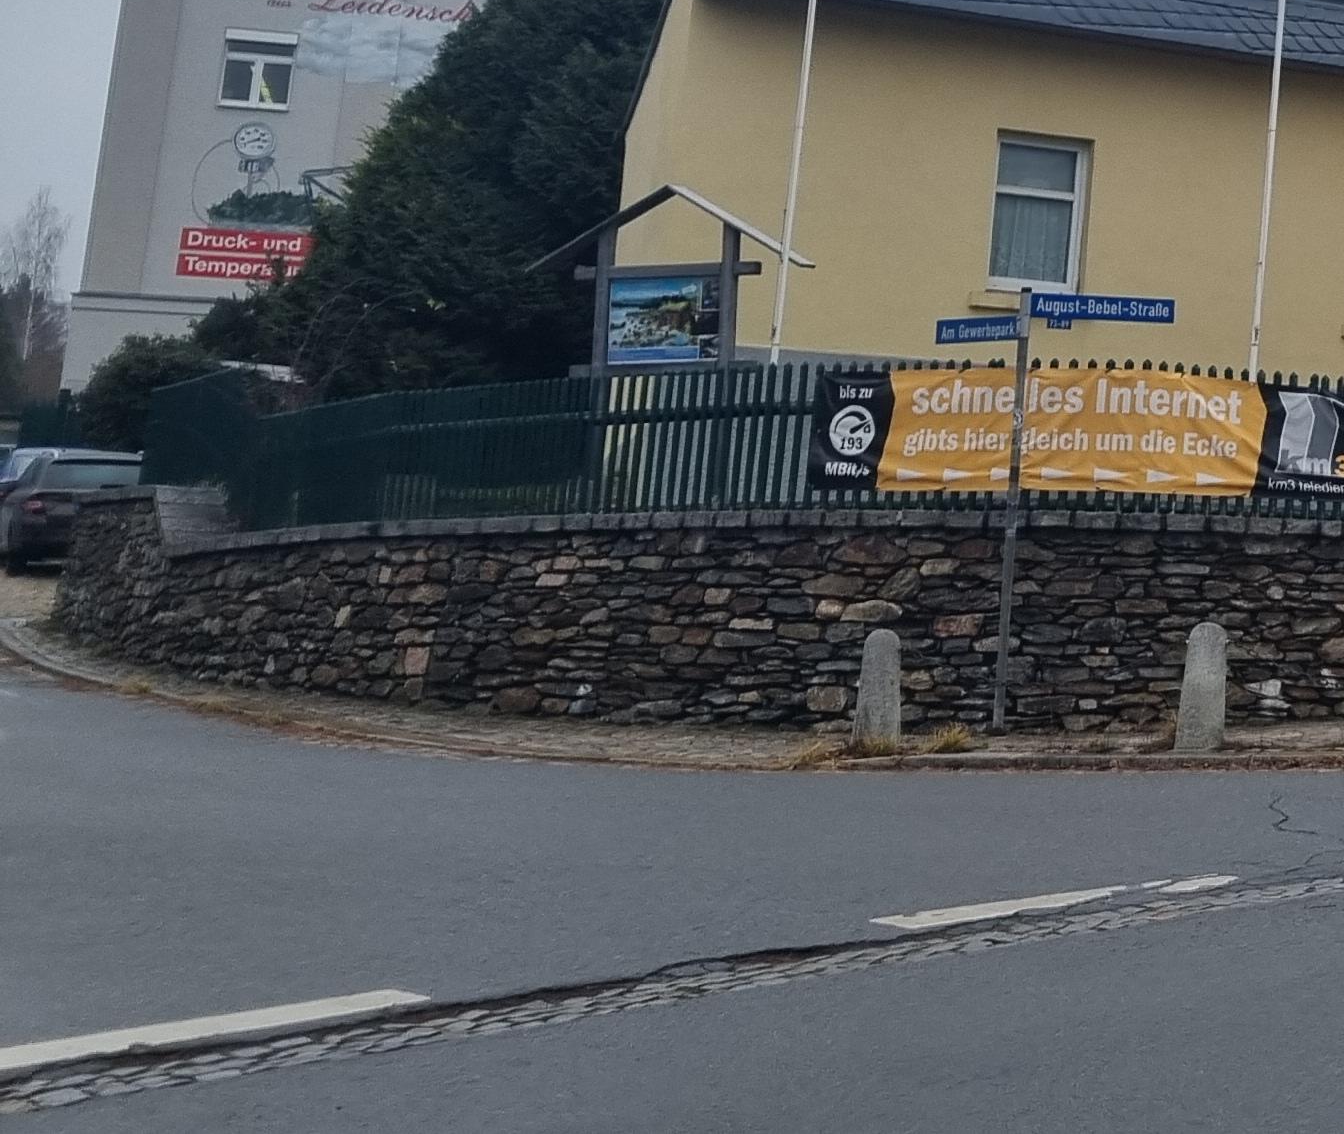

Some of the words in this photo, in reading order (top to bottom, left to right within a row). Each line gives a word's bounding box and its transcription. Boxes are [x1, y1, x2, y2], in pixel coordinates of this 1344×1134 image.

[187, 230, 257, 250] Druck-
[263, 237, 302, 252] und
[1036, 298, 1170, 318] August-Bebel-Straße
[940, 325, 955, 341] Am
[958, 320, 1017, 341] Gewerbepark
[839, 385, 857, 399] bis
[858, 387, 873, 399] zu
[1095, 377, 1243, 424] Internet
[839, 436, 863, 450] 193
[903, 427, 959, 457] gibts
[963, 427, 1010, 452] hier
[1095, 433, 1133, 452] um
[1140, 428, 1177, 453] die
[1182, 431, 1238, 459] Ecke
[1267, 477, 1296, 491] km3
